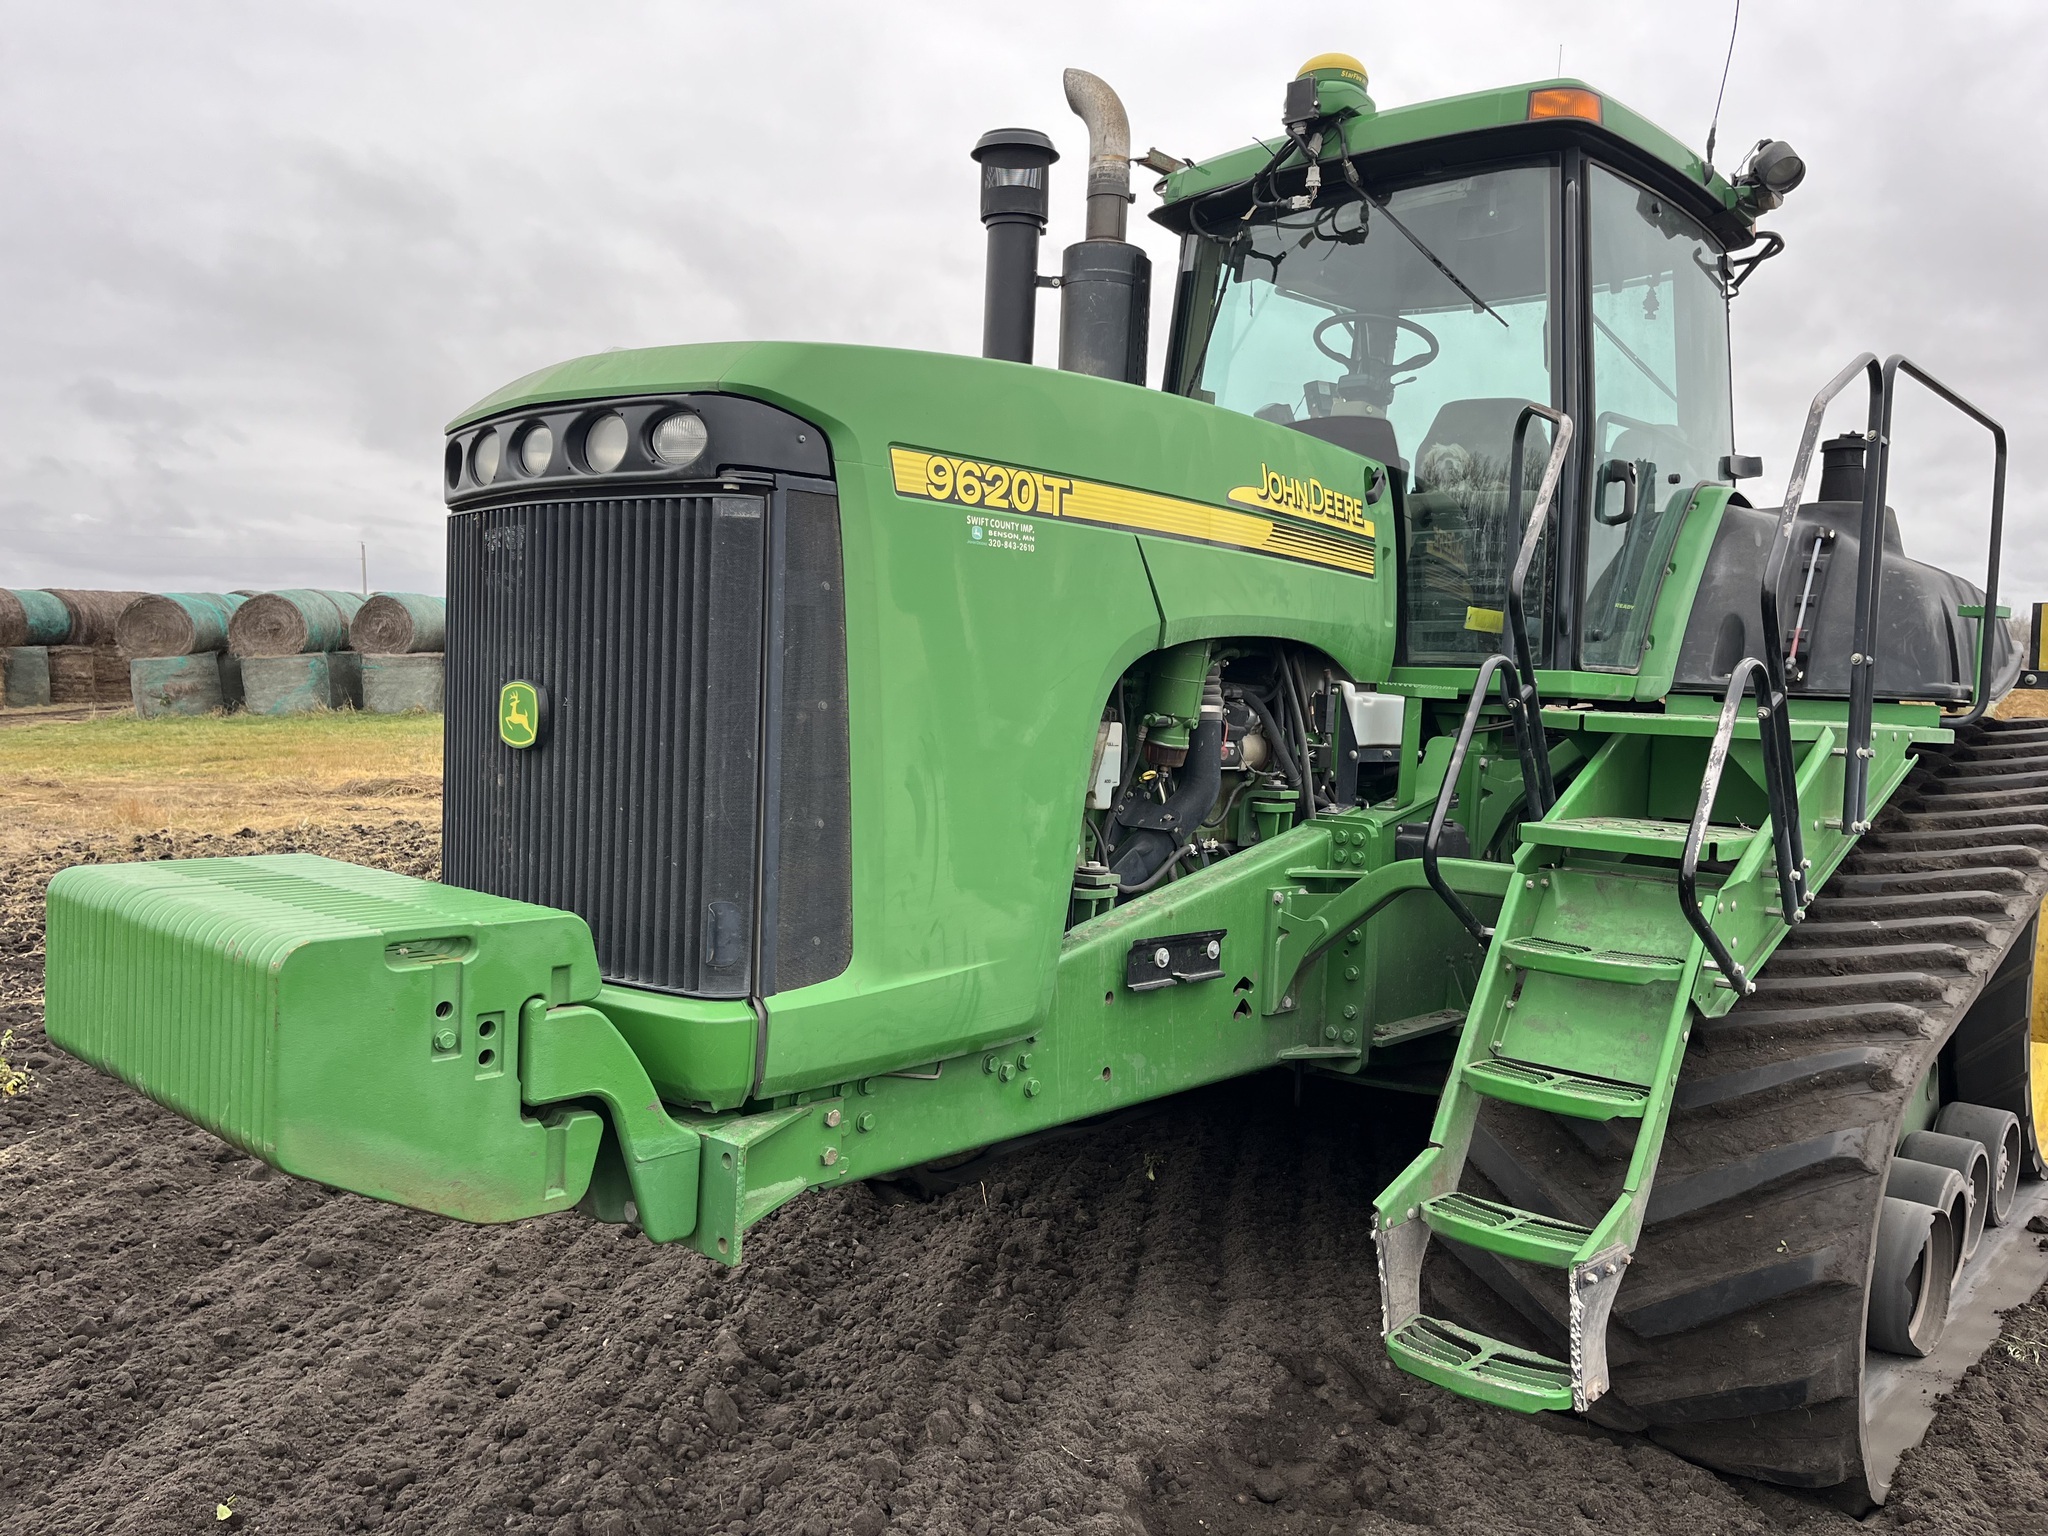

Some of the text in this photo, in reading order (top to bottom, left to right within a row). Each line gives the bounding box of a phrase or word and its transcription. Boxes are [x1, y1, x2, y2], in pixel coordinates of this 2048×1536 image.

[925, 454, 1072, 517] 9620T
[1256, 462, 1365, 528] JOHN DEERE
[966, 515, 1035, 534] SWIFT COUNTY IMP.
[988, 529, 1035, 543] BENSON, MN
[988, 538, 1035, 553] 320-843-2610
